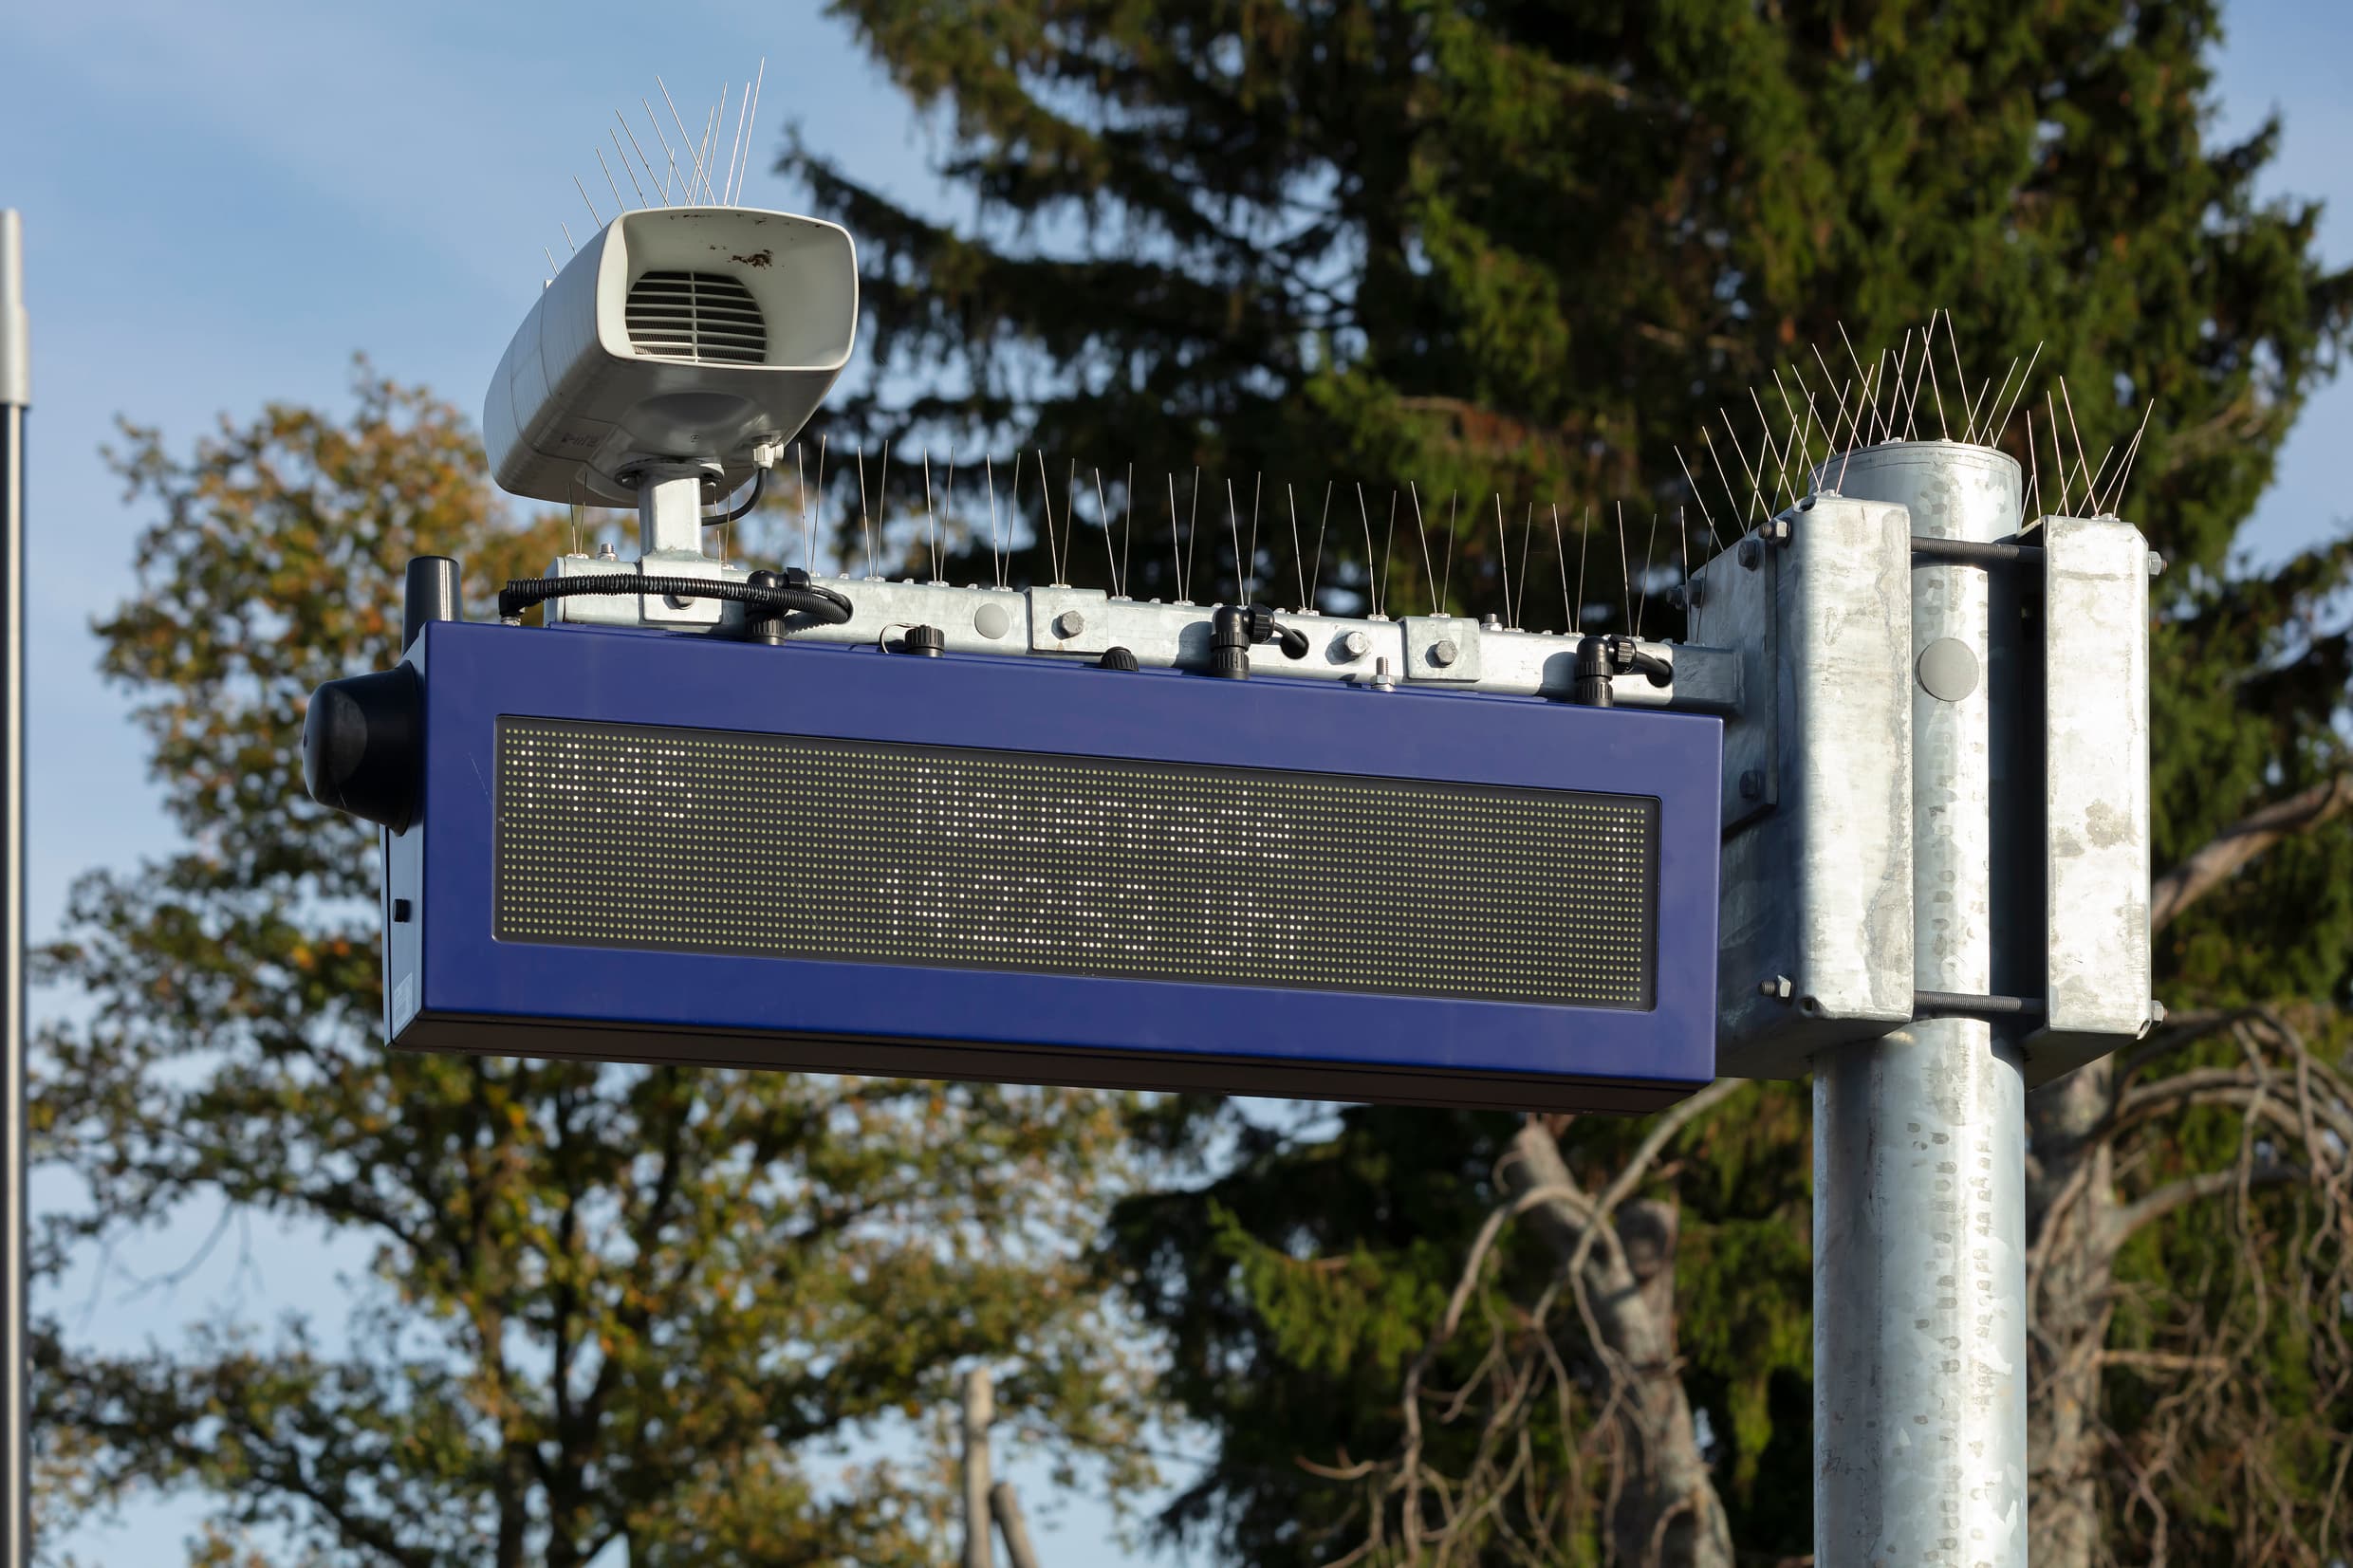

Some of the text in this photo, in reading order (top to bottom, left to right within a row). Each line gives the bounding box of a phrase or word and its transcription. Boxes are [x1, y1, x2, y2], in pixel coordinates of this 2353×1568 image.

[512, 740, 693, 820] 14:45
[917, 767, 1290, 859] Neuenrade
[1604, 816, 1625, 883] 1
[879, 868, 1309, 960] 14:22:53 Uhr
